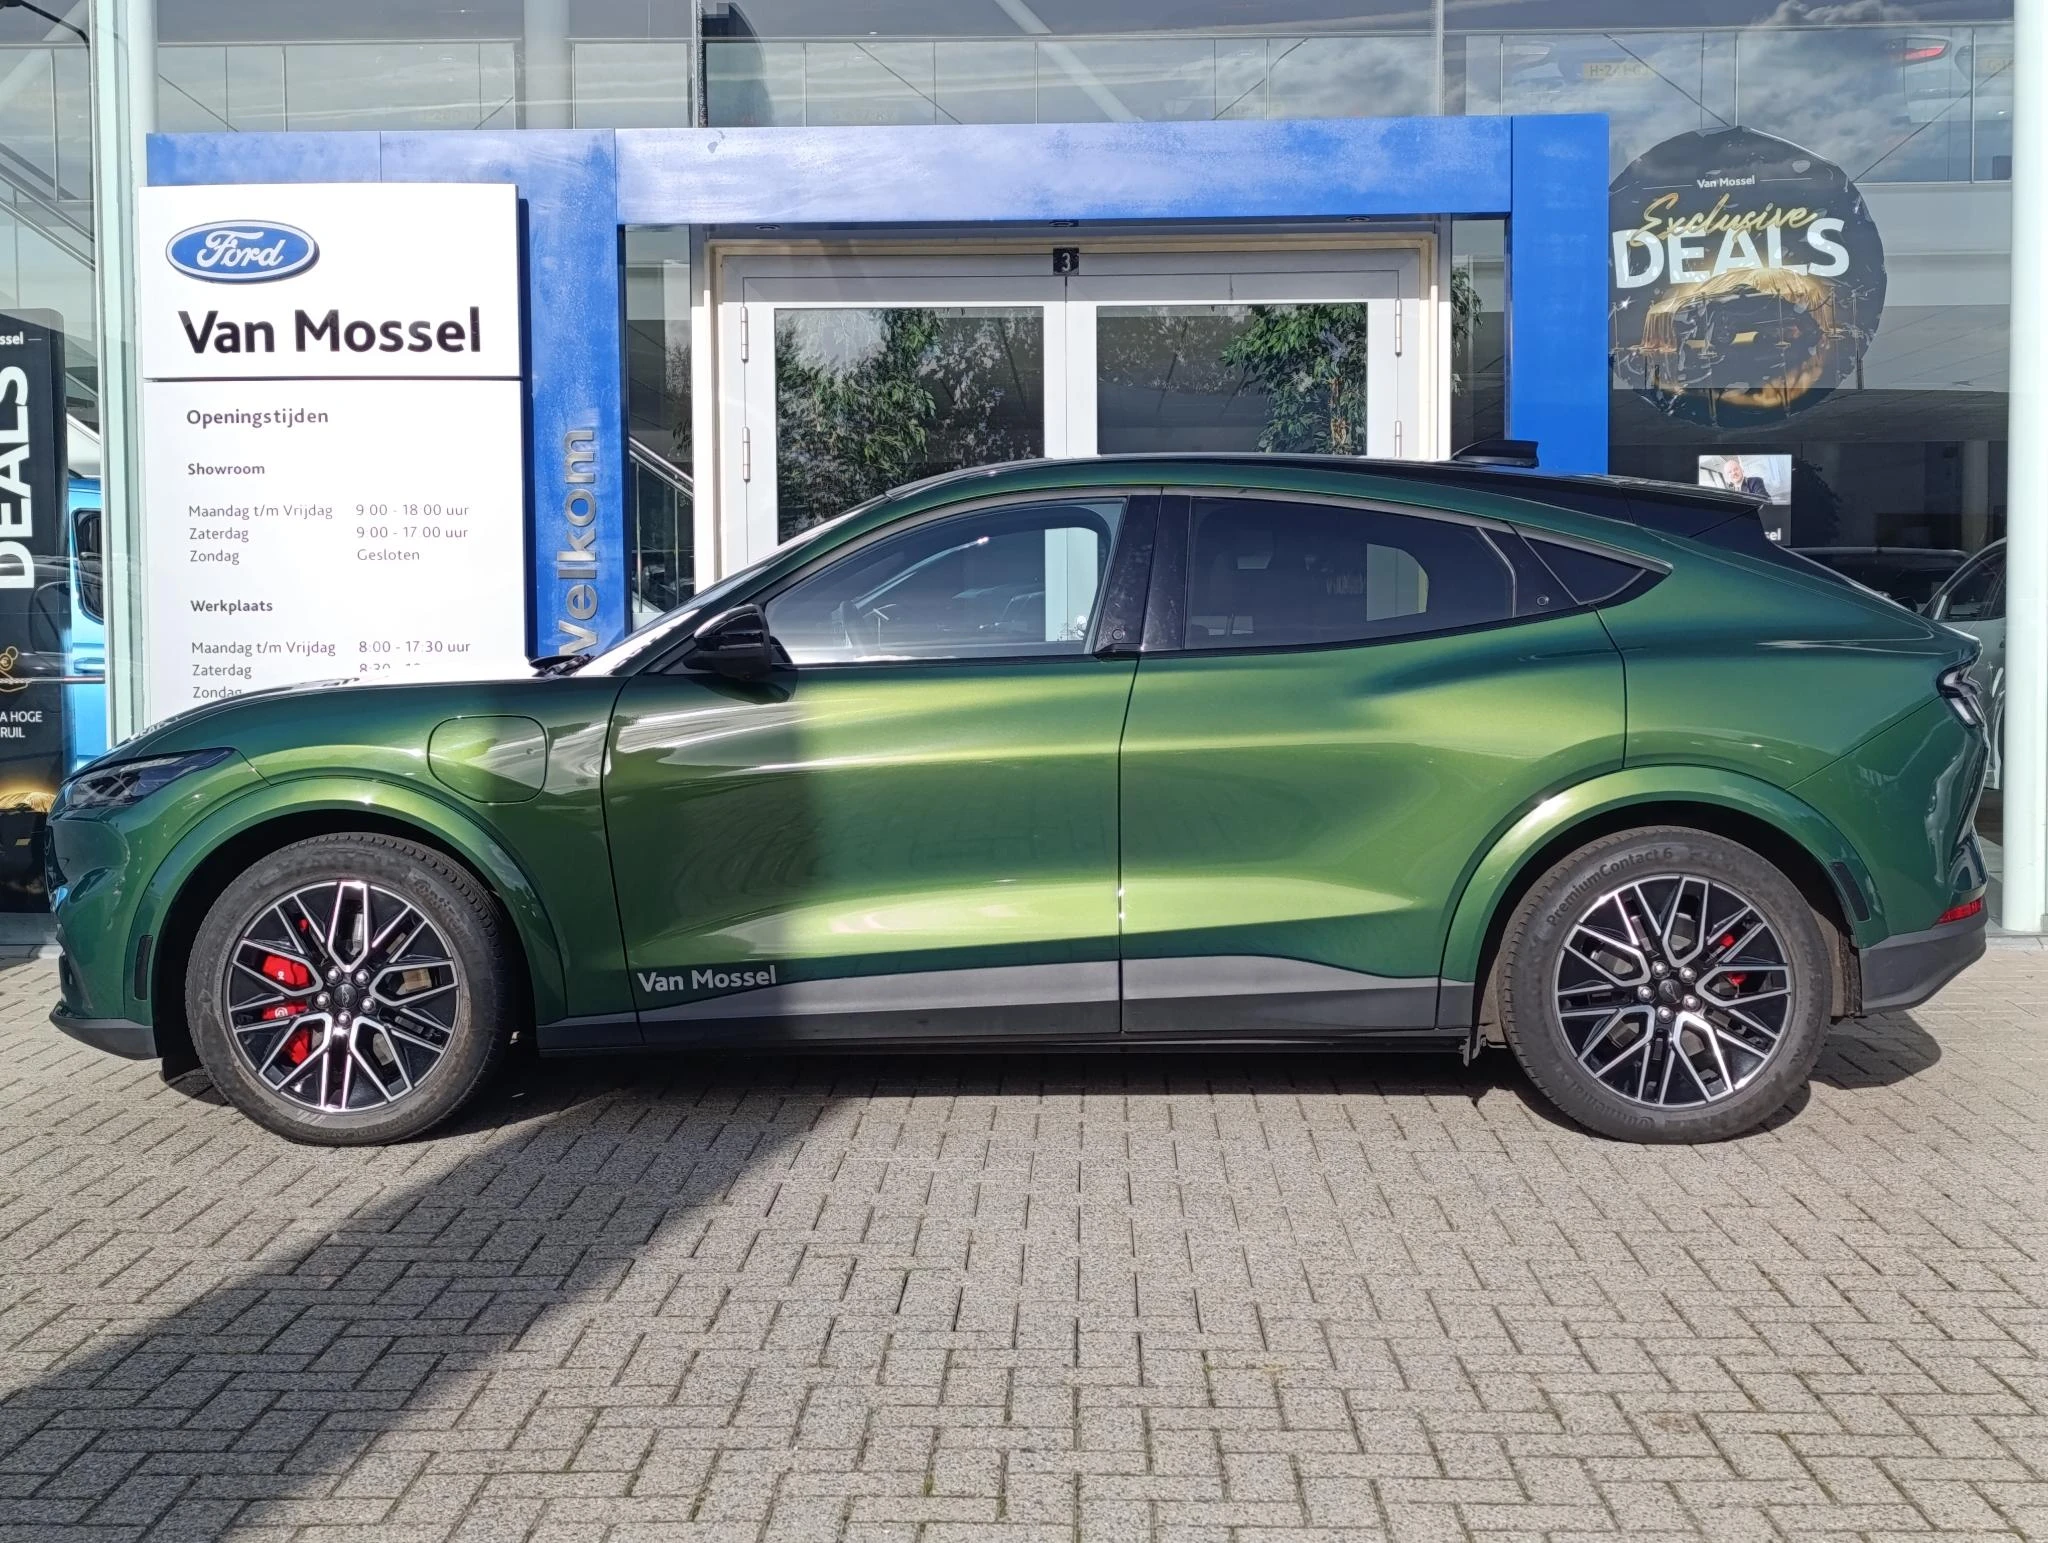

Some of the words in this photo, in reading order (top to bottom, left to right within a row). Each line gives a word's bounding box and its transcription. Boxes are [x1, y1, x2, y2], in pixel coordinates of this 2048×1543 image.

[1697, 179, 1717, 189] Van
[1720, 175, 1756, 187] Mossel
[1629, 192, 1818, 247] Exclusive
[196, 230, 286, 268] Ford
[1612, 217, 1850, 288] DEALS
[1062, 252, 1071, 271] 3
[177, 309, 276, 354] Van
[294, 306, 481, 353] Mossel
[186, 407, 329, 429] Openingstijden
[187, 462, 265, 475] Showroom
[189, 504, 250, 520] Maandag
[253, 505, 279, 517] t/m
[283, 503, 333, 519] Vrijdag
[446, 506, 470, 516] uur
[189, 527, 250, 543] Zaterdag
[445, 529, 468, 538] uur
[189, 550, 240, 566] Zondag
[357, 548, 420, 561] Gesloten
[190, 600, 273, 615] Werkplaats
[191, 641, 253, 657] Maandag
[256, 642, 282, 654] t/m
[286, 640, 337, 656] Vrijdag
[447, 643, 471, 653] uur
[192, 663, 252, 679] Zaterdag
[10, 711, 43, 723] HOGE
[0, 726, 26, 739] RUIL
[1662, 847, 1673, 860] 6
[637, 971, 684, 993] Van
[691, 964, 776, 989] Mossel
